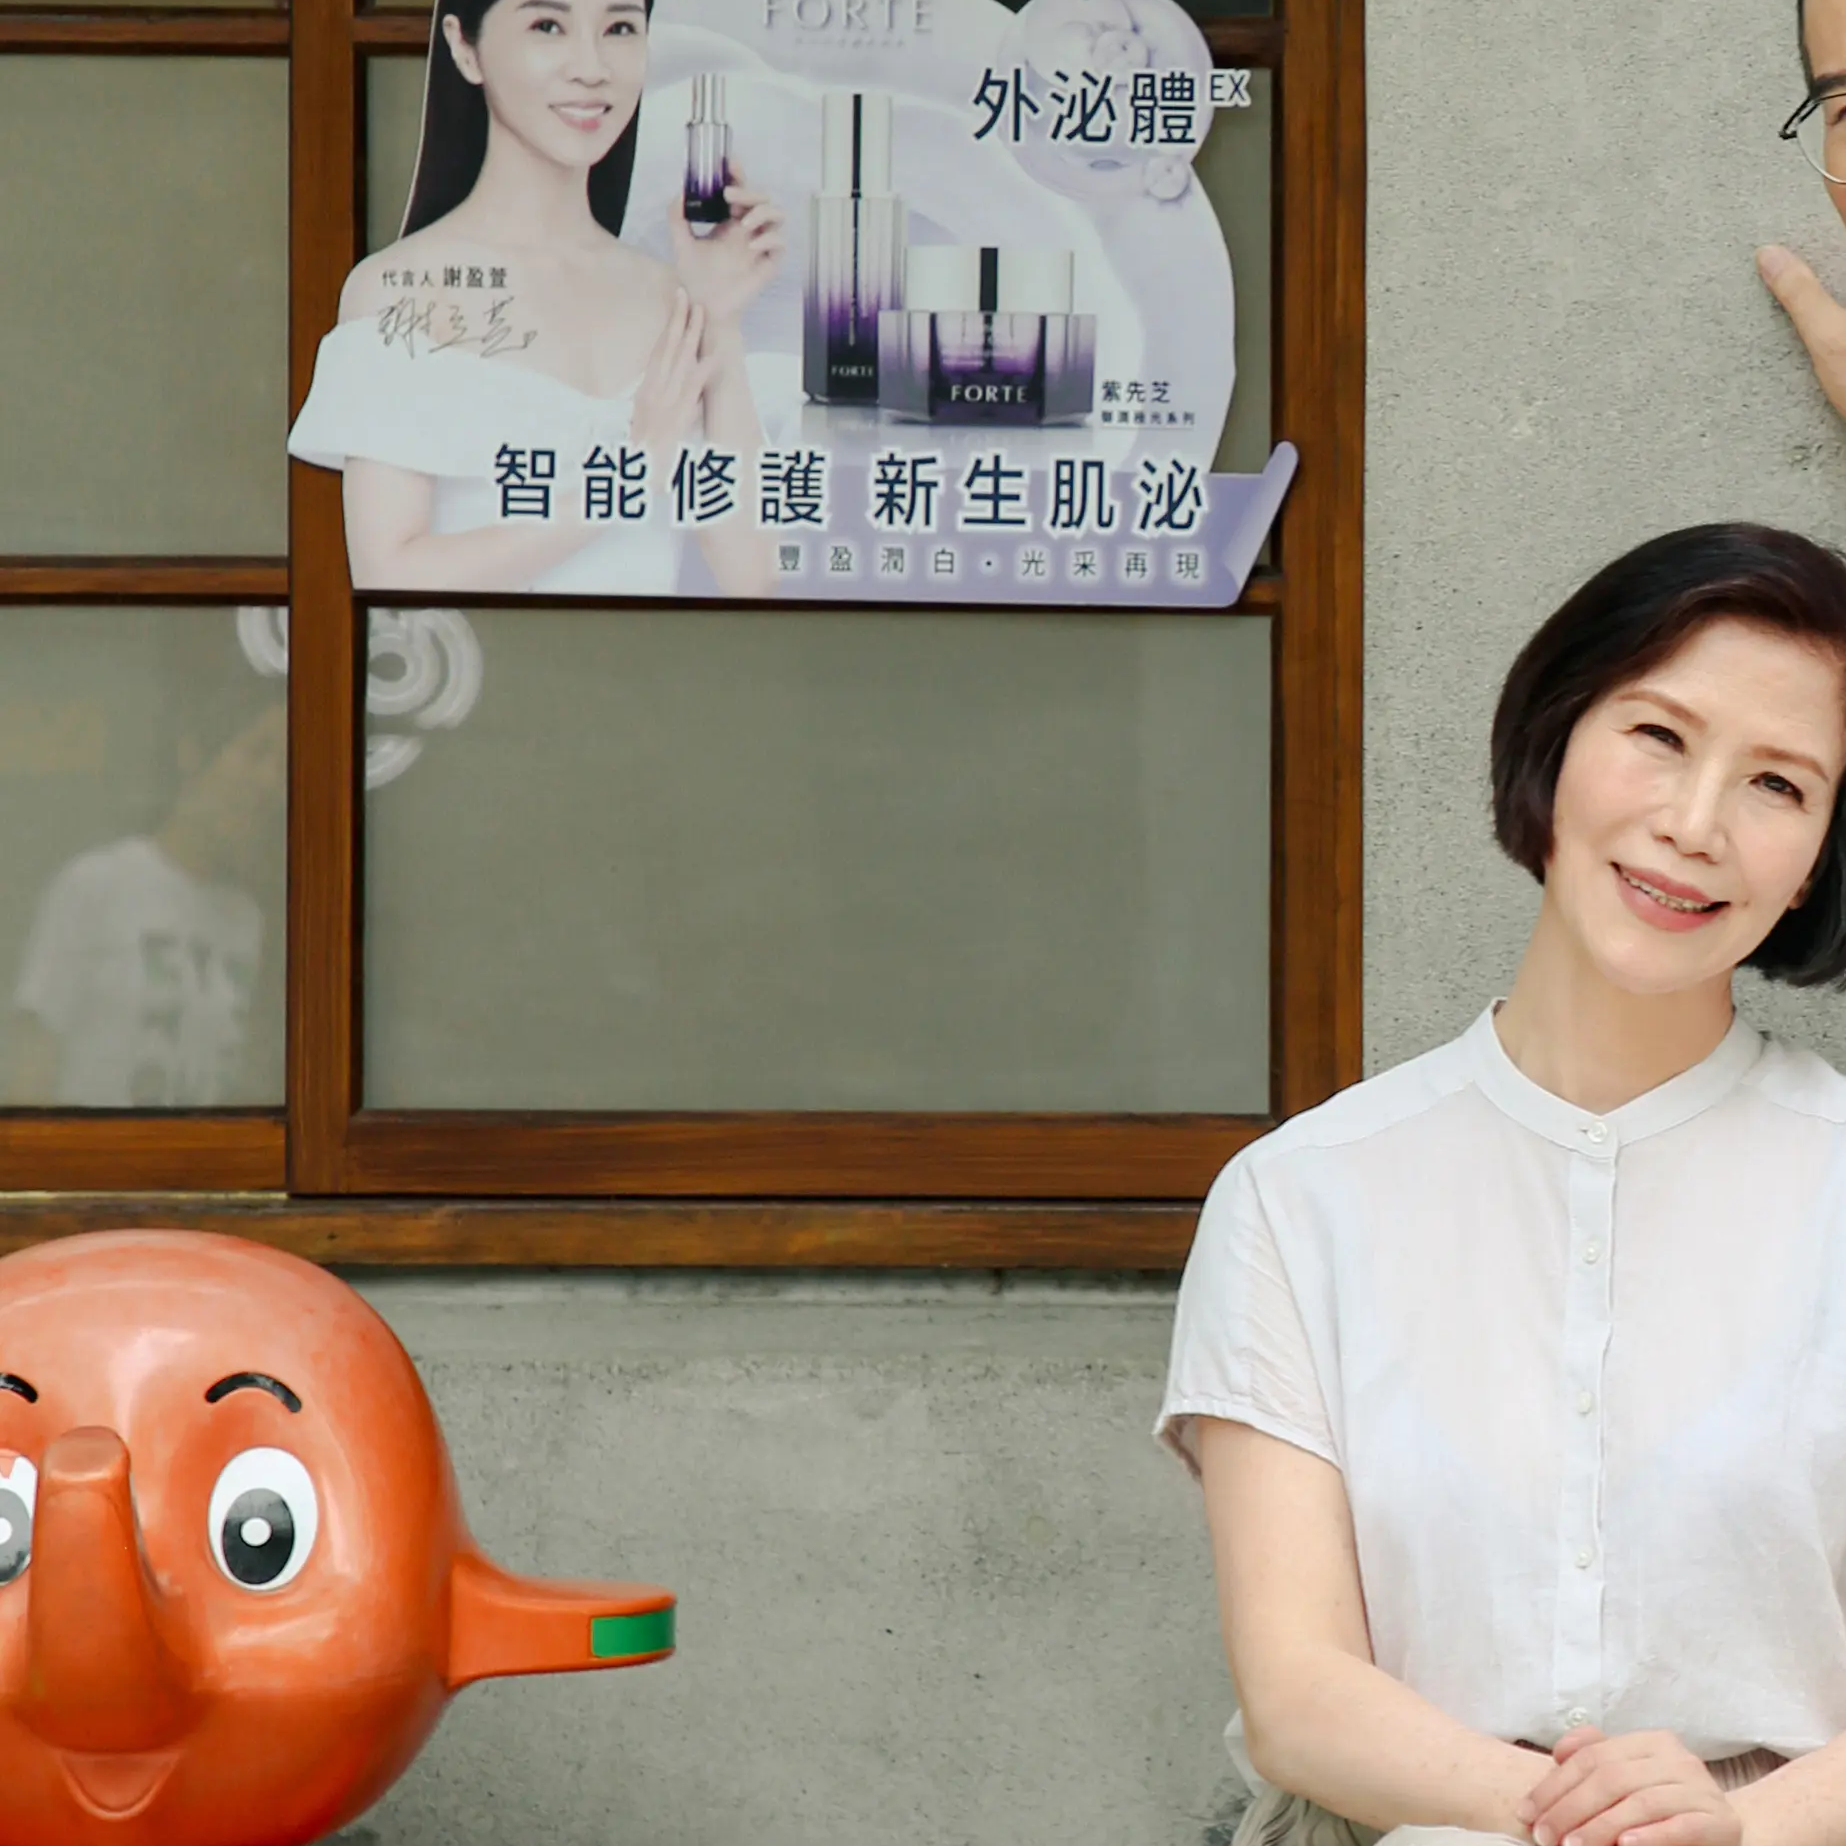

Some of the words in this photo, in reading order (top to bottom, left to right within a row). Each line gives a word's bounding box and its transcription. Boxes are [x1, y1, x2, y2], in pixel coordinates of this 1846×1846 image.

[972, 67, 1198, 145] 外泌體
[1210, 74, 1248, 102] EX
[382, 269, 435, 288] 代言人
[951, 383, 1028, 403] FORTE
[1101, 380, 1171, 404] 紫先芝
[494, 442, 826, 526] 智能修護
[873, 453, 1203, 531] 新生肌泌
